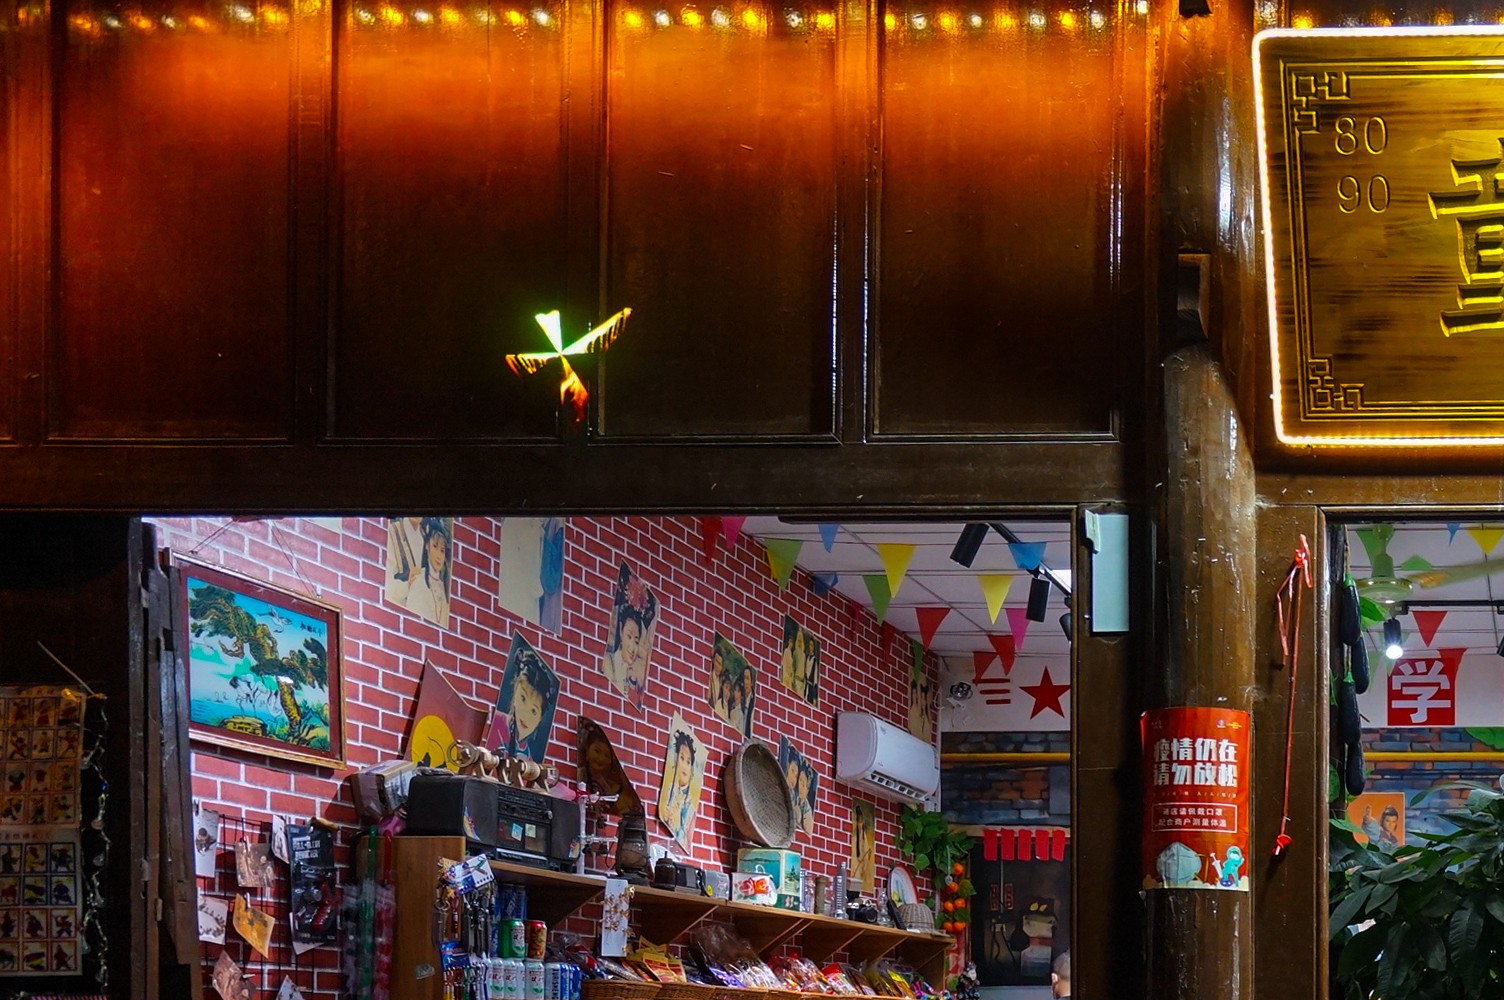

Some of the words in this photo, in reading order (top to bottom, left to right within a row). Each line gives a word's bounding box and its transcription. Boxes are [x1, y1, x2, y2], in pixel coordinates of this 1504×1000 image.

[1334, 115, 1389, 156] 80
[1336, 175, 1392, 216] 90
[1153, 737, 1238, 763] 疫情仍在
[1153, 763, 1238, 787] 请勿放松
